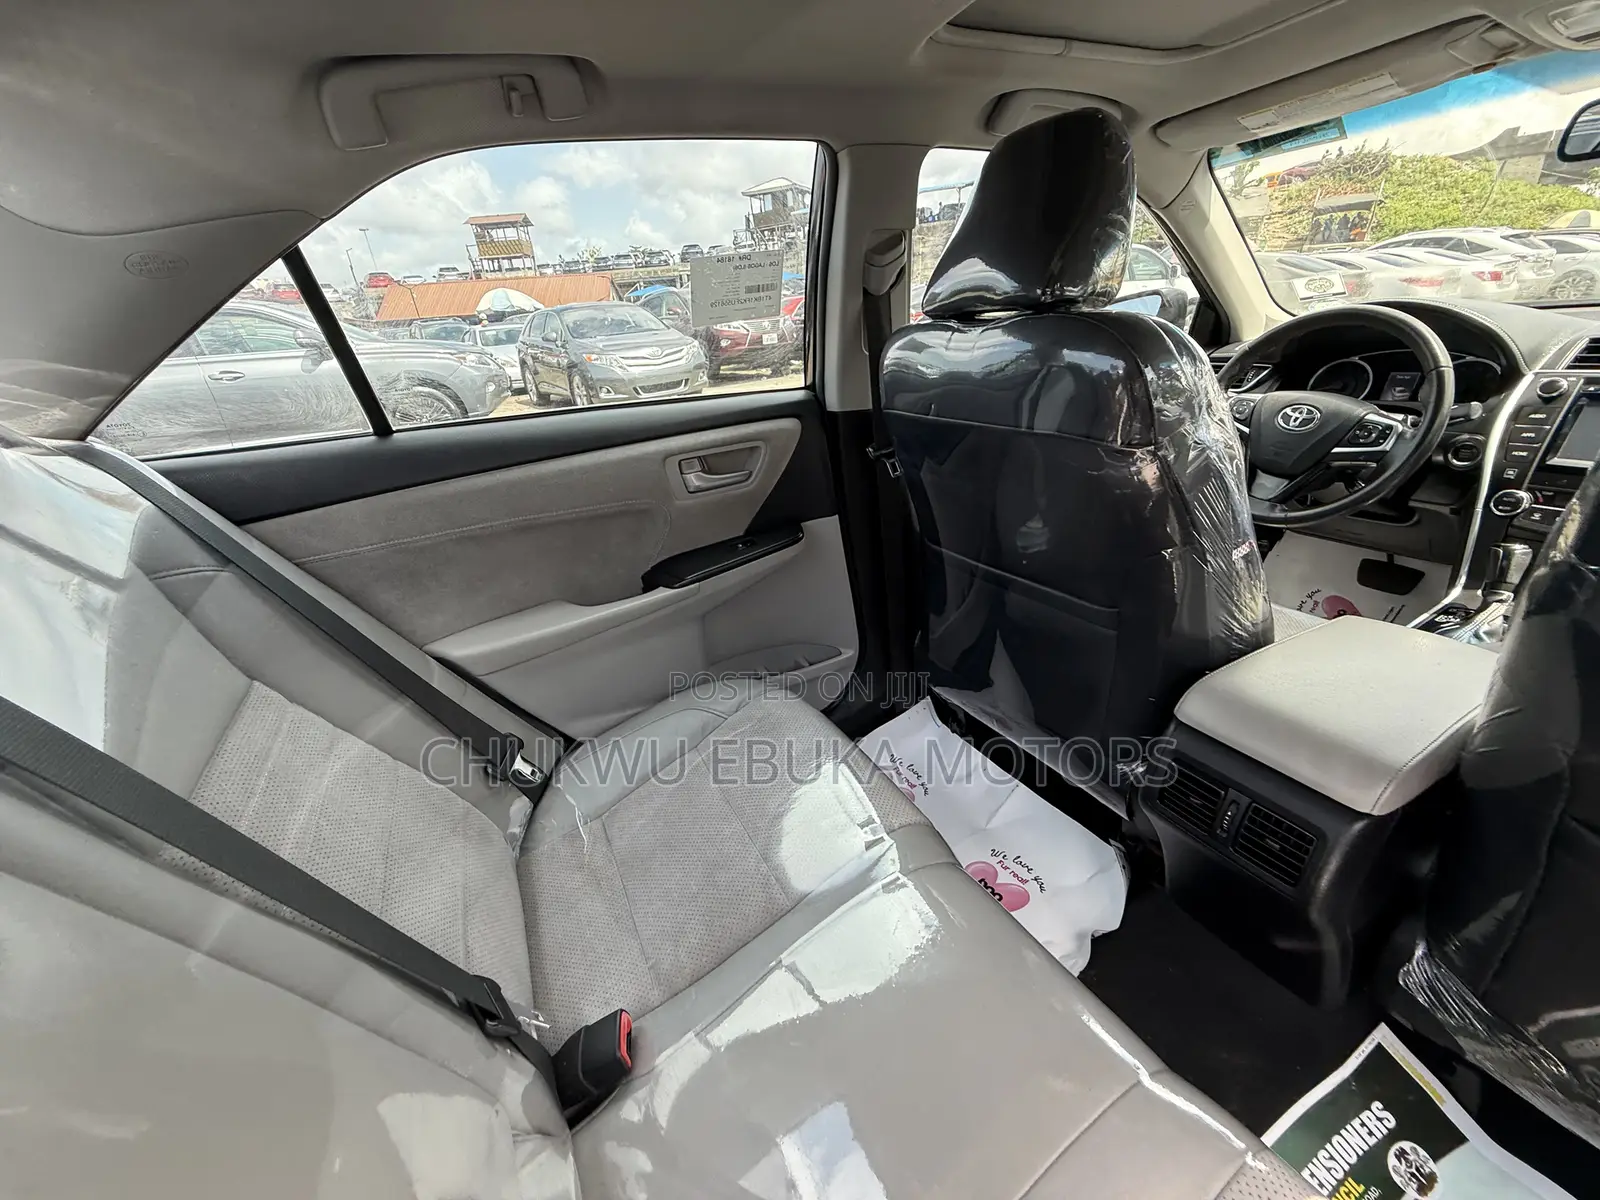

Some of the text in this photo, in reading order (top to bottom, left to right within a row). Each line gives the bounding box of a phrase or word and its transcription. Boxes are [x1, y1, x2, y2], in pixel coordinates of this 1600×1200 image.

[890, 754, 929, 796] We love you
[990, 848, 1046, 894] We love you
[996, 859, 1010, 871] Fur
[1300, 1100, 1397, 1197] ENSIONERS
